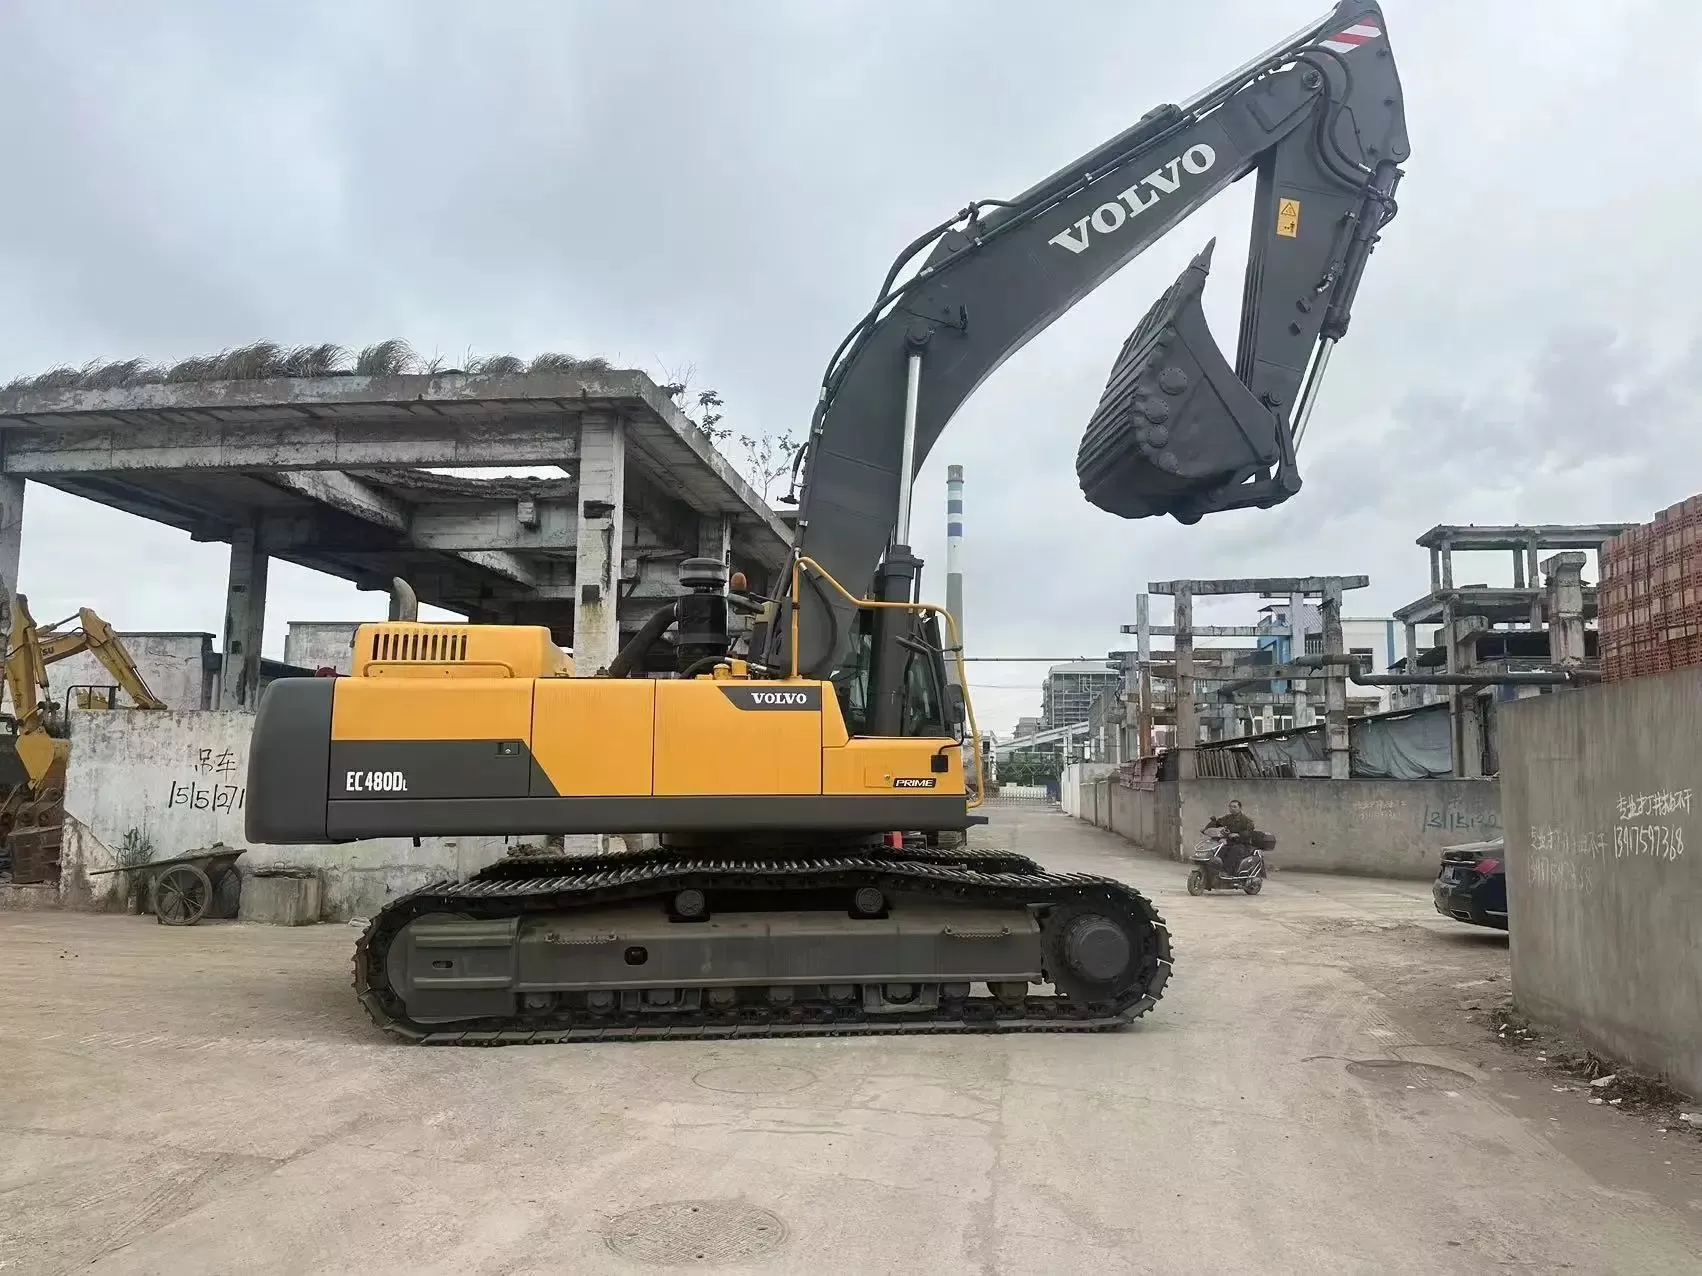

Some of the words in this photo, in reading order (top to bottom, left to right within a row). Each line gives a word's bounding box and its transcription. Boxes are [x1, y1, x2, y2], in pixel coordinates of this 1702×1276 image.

[1048, 143, 1216, 254] VOLVO
[751, 692, 807, 704] VOLVO
[195, 748, 236, 781] 吊车
[895, 779, 934, 788] PRIME
[1613, 824, 1685, 861] 13917597368
